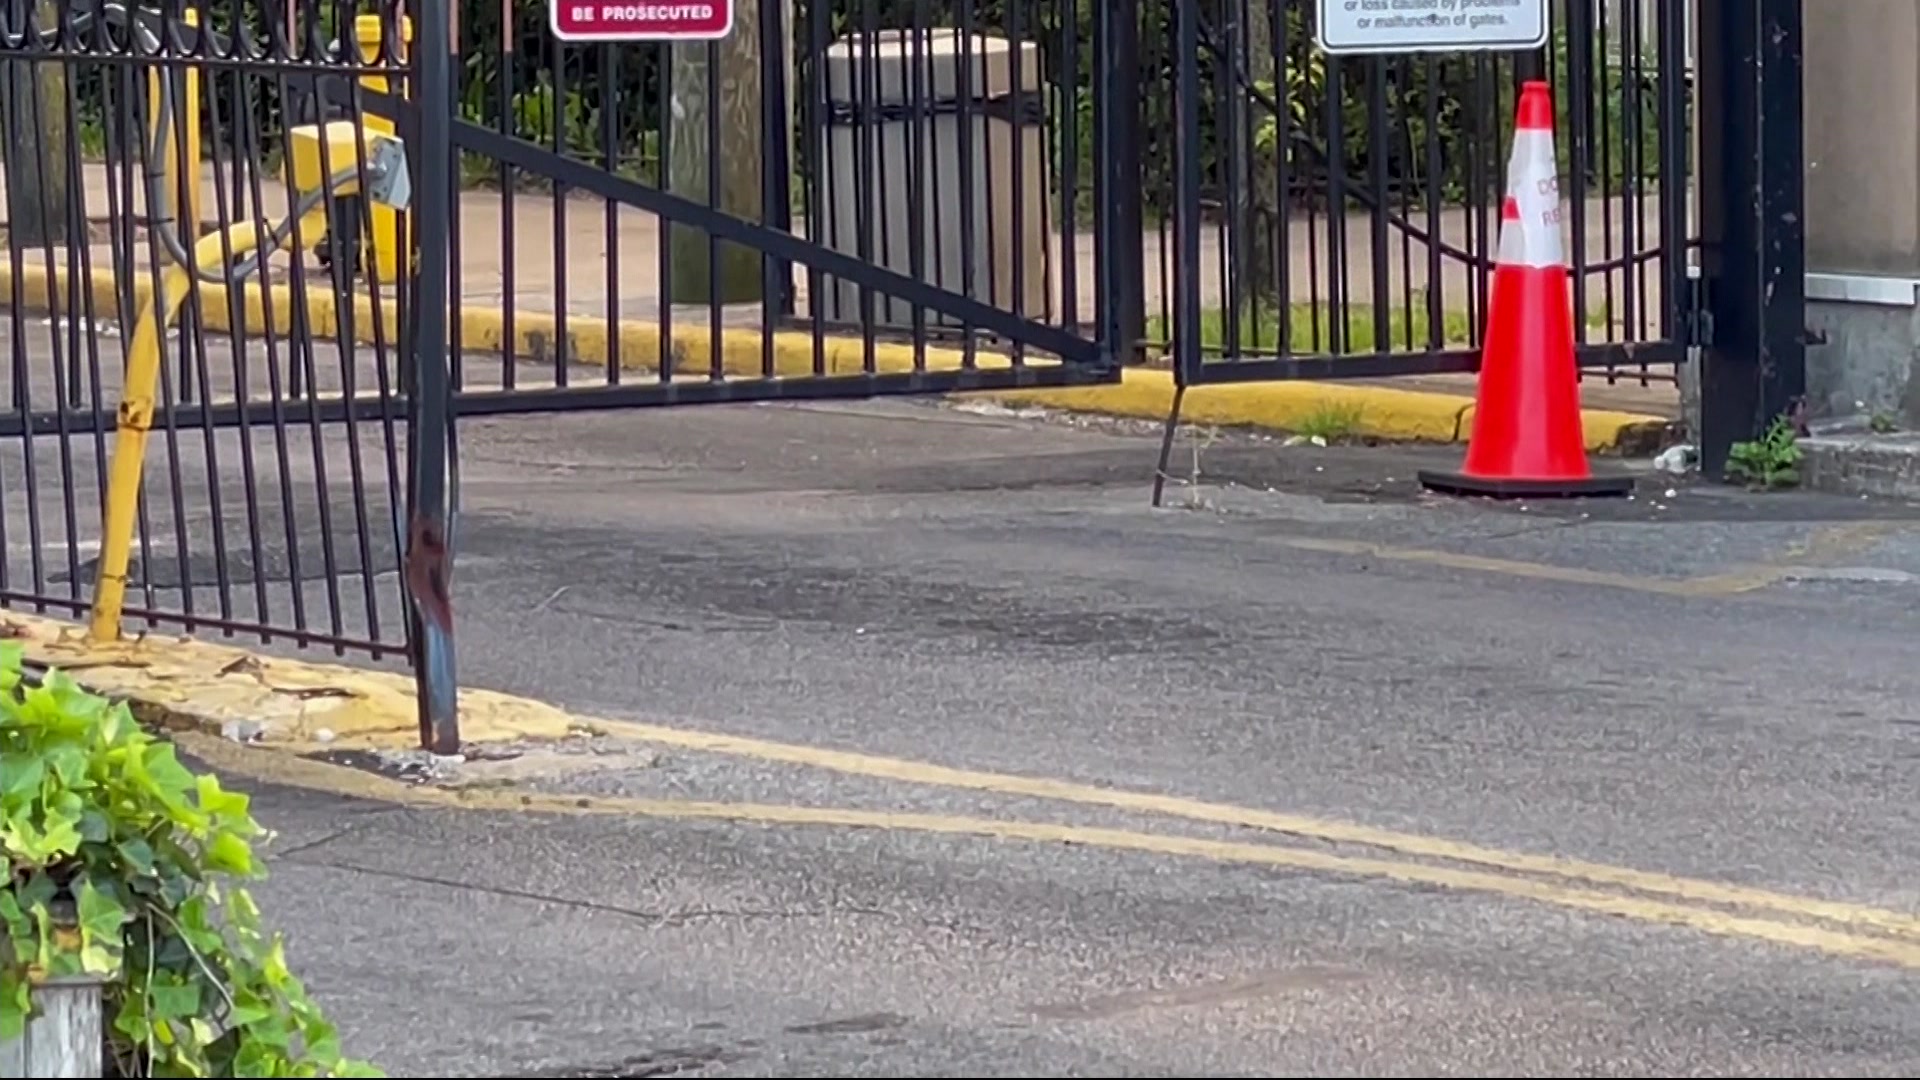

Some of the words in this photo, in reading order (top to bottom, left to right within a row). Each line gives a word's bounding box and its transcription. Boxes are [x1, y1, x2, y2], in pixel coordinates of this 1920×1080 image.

[571, 7, 594, 21] BE
[602, 5, 713, 20] PROSECUTED
[1344, 1, 1357, 11] or
[1361, 0, 1387, 10] loss
[1357, 18, 1371, 29] or
[1375, 15, 1450, 28] malfunction
[1453, 14, 1466, 26] of
